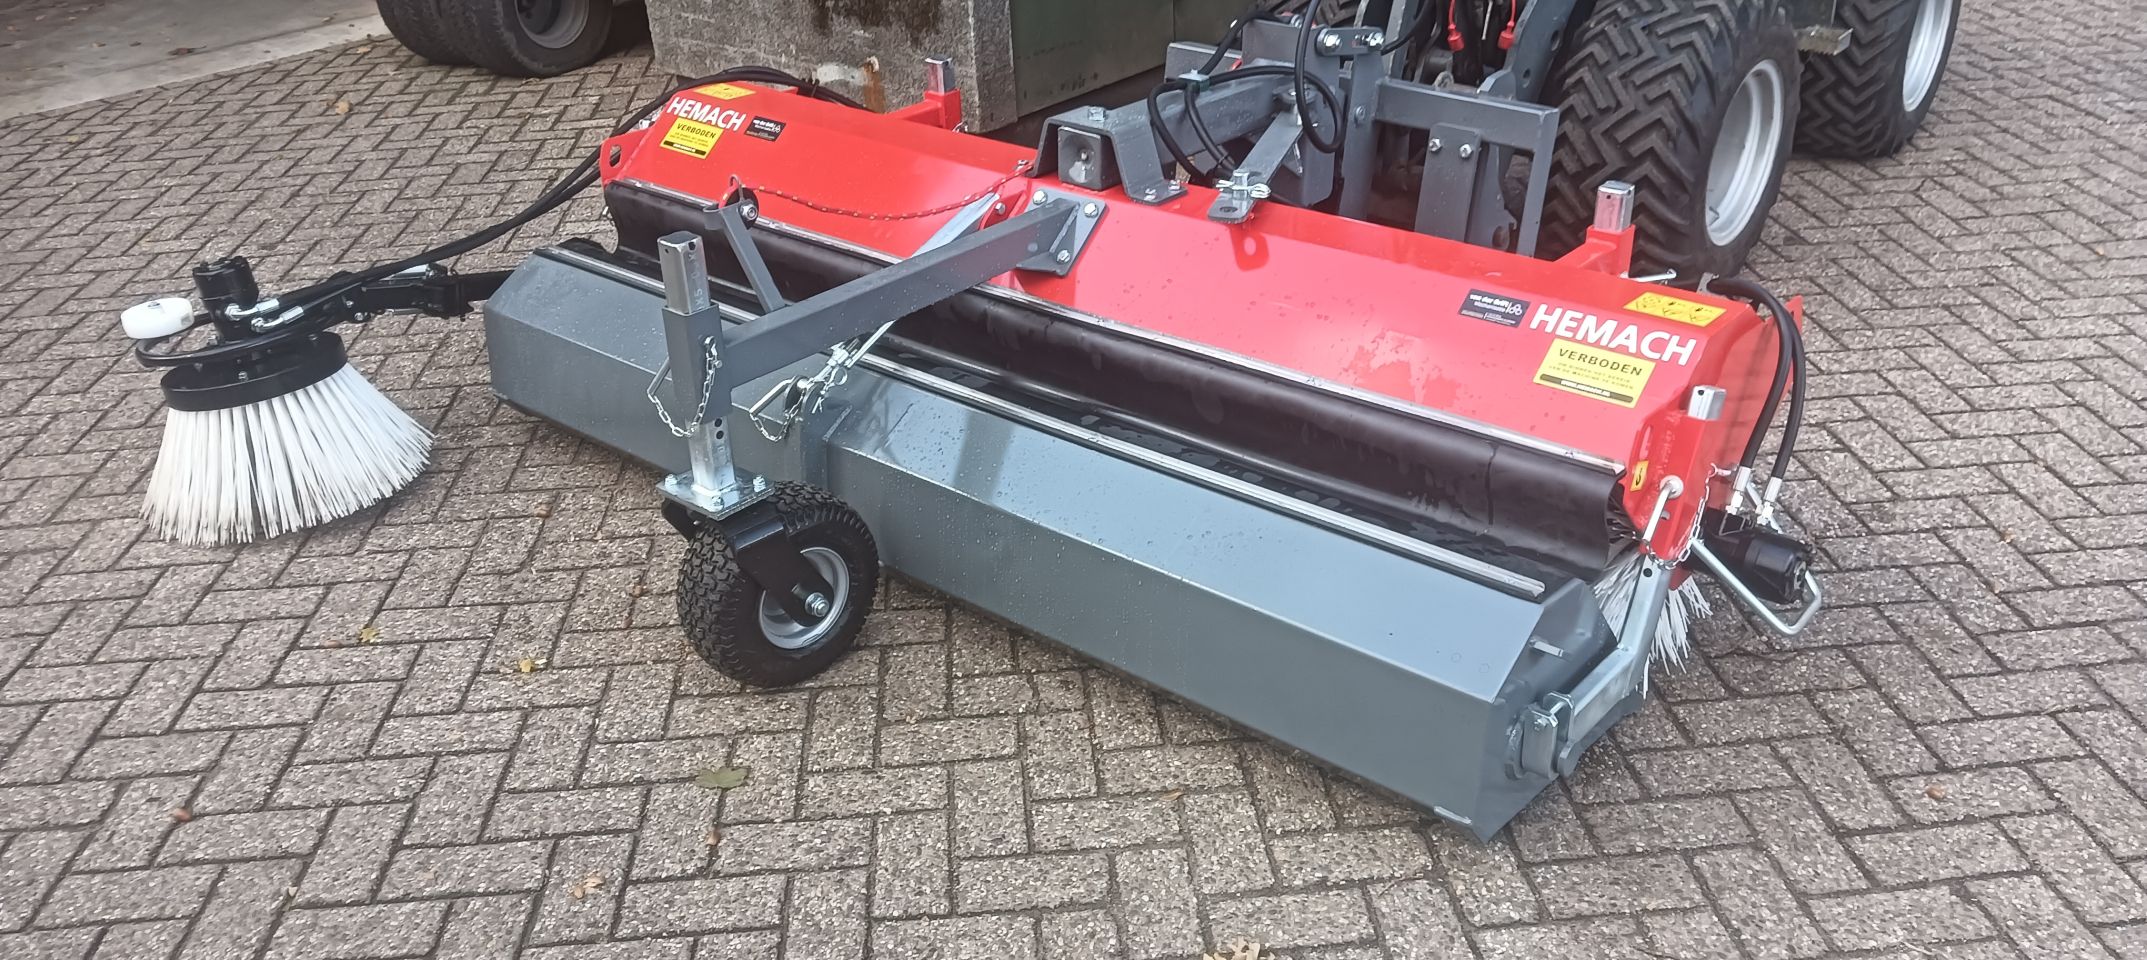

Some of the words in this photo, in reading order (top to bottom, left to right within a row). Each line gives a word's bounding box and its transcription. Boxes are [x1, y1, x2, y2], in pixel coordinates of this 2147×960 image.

[667, 97, 747, 132] HEMACH
[677, 123, 716, 139] VERBODEN
[1530, 304, 1697, 366] HEMACH
[1559, 348, 1643, 376] VERBODEN
